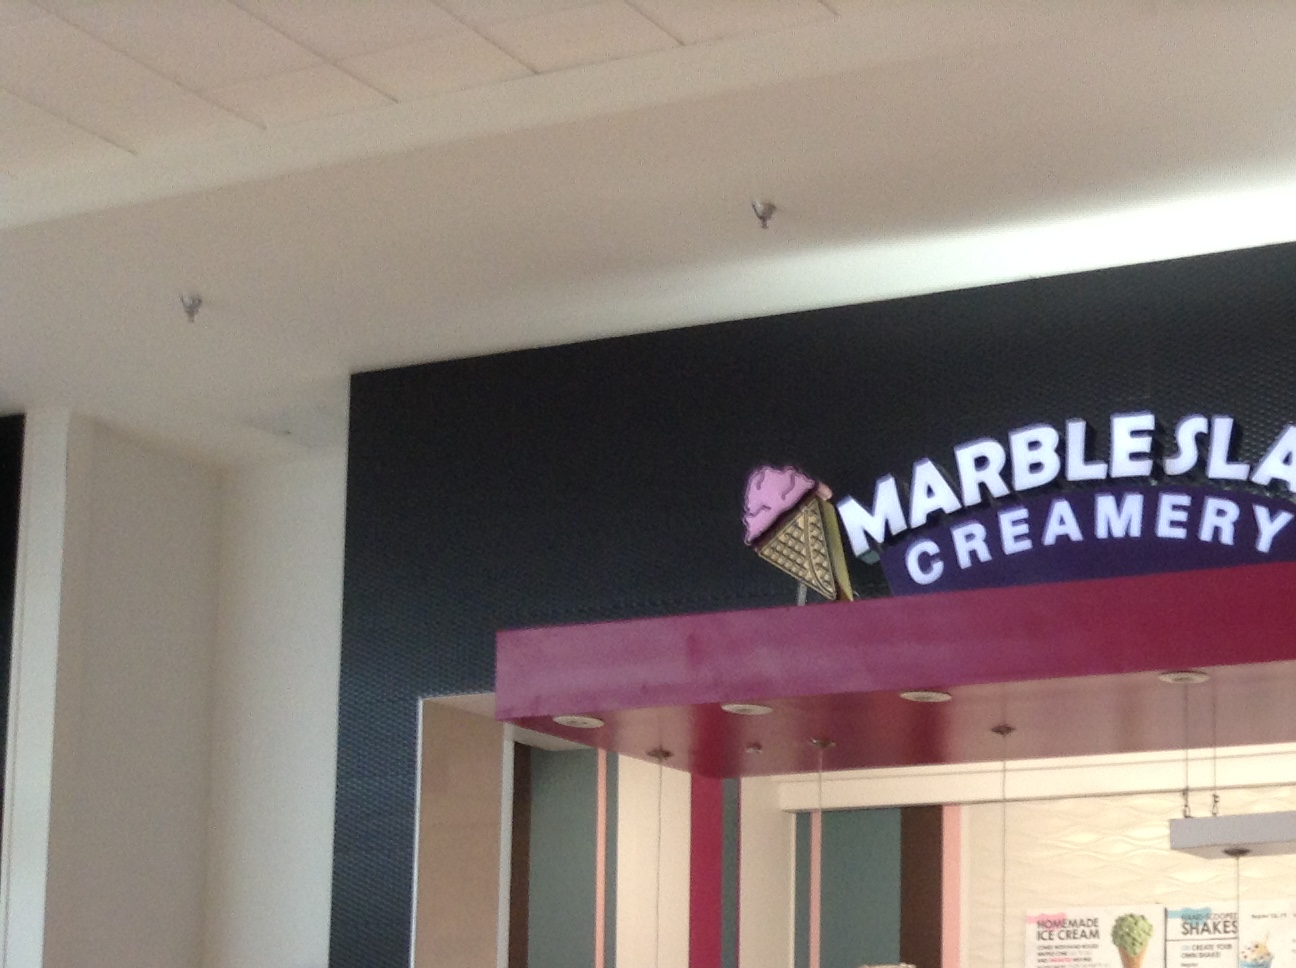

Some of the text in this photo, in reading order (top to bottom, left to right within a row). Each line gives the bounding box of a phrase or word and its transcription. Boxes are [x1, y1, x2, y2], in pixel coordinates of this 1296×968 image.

[904, 492, 1294, 586] CREAMERY
[1036, 917, 1100, 929] HOMEMADE
[1181, 920, 1238, 936] SHAKES
[1036, 928, 1101, 941] ICE CREAM
